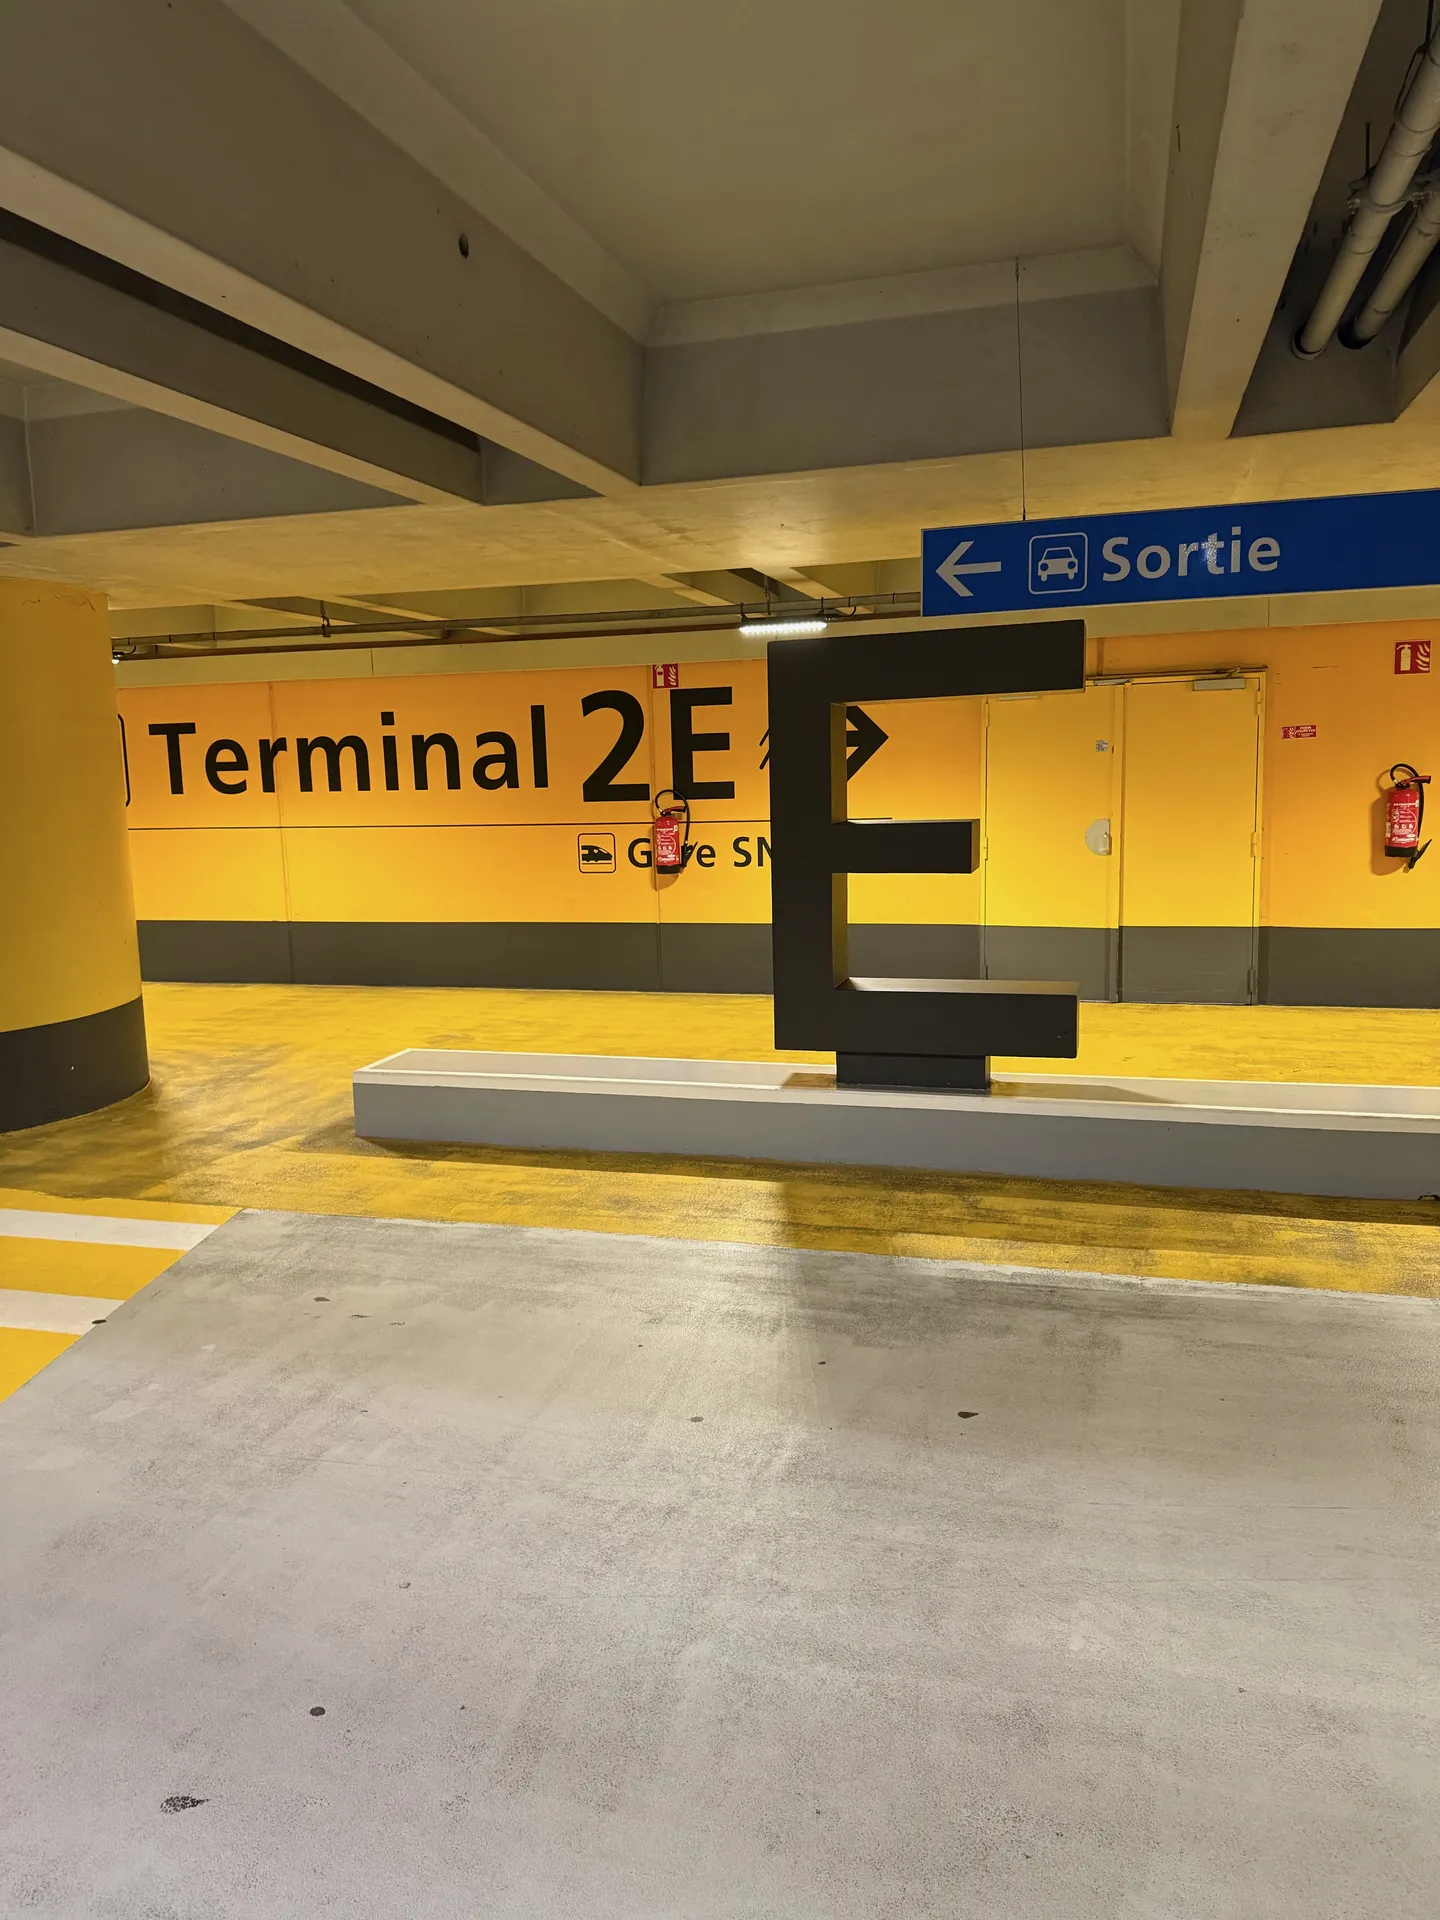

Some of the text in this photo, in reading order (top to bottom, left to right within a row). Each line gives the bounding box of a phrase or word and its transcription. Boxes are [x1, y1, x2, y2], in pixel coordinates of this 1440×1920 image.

[1102, 526, 1281, 582] Sortie
[148, 686, 735, 802] Terminal 2E
[628, 837, 717, 868] Ge
[733, 836, 772, 868] SN
[768, 619, 1086, 1058] E
